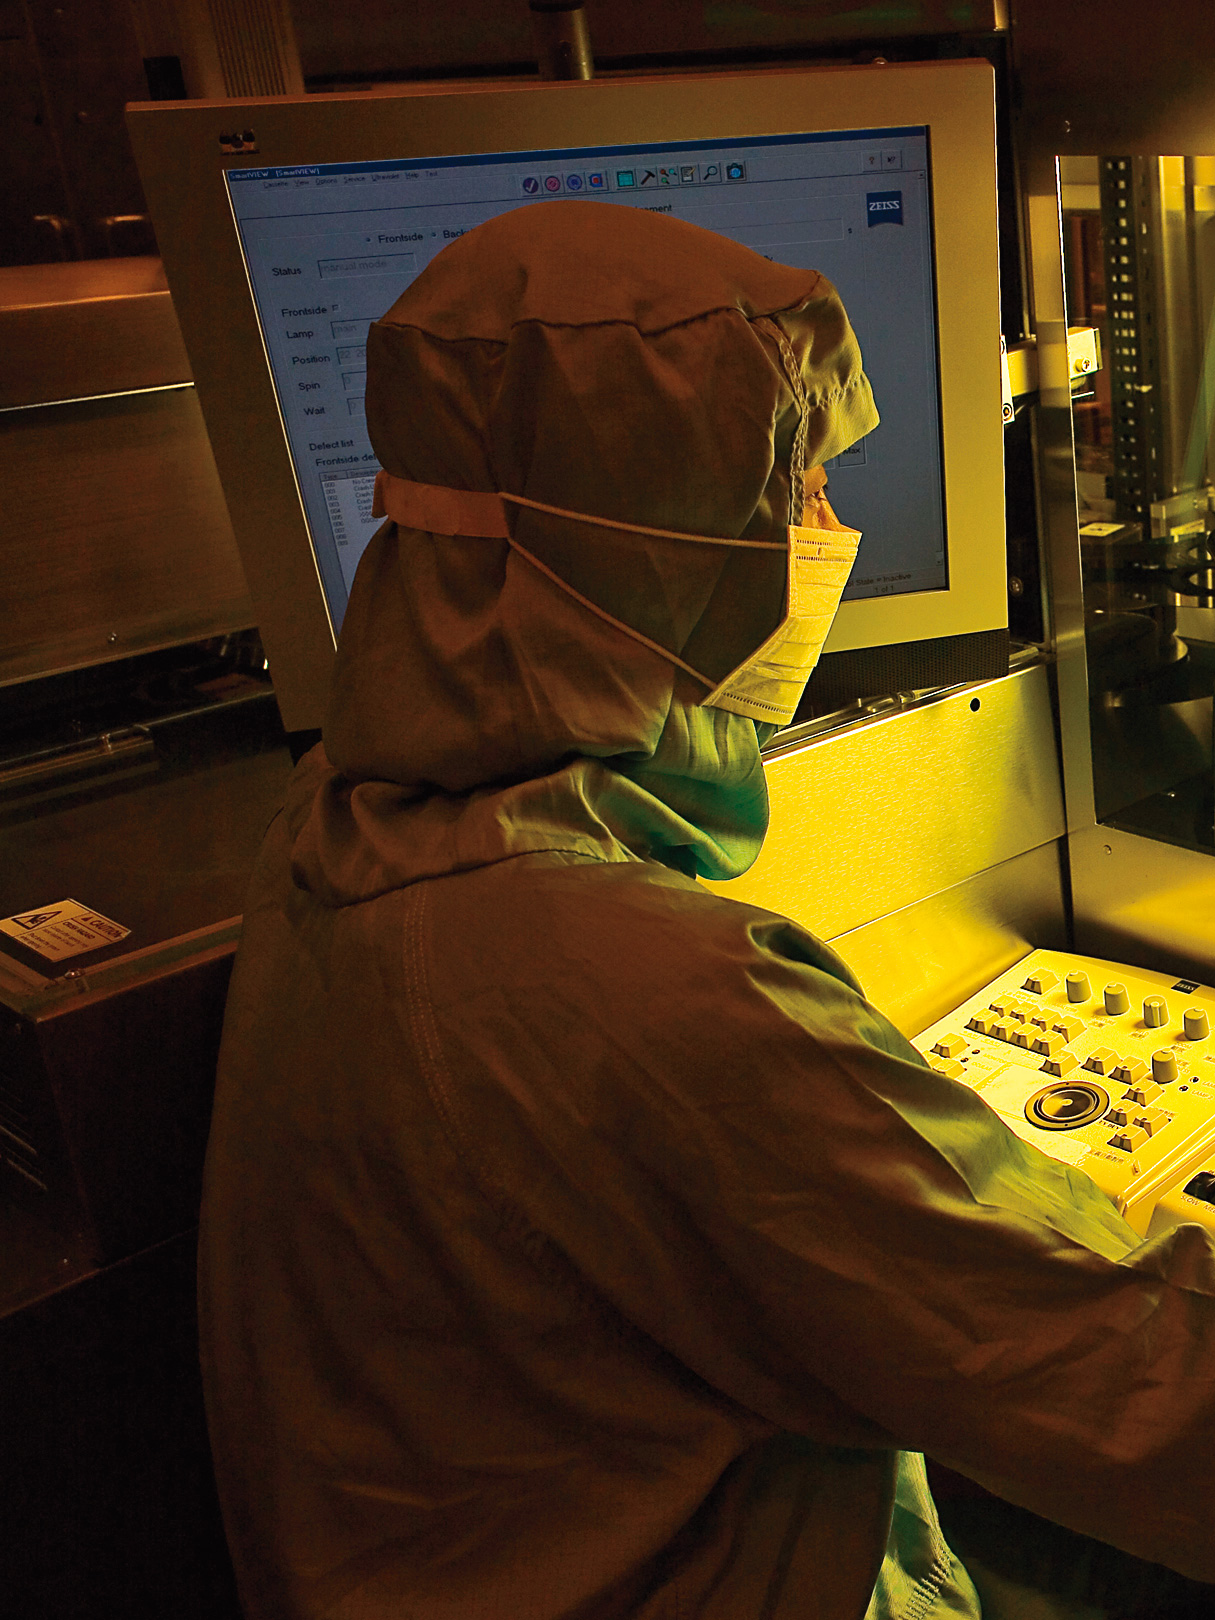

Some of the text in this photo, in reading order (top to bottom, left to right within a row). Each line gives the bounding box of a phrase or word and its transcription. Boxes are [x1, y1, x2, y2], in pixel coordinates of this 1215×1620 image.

[869, 200, 900, 211] ZEISS
[378, 233, 423, 243] Frontside
[272, 266, 302, 277] Status
[281, 306, 327, 317] Frontside
[286, 331, 313, 339] Lamp
[292, 355, 330, 364] Position
[298, 382, 320, 392] Spin
[304, 407, 325, 415] Wait
[309, 441, 339, 450] Defect
[316, 455, 359, 466] Frontside
[884, 574, 911, 582] Inactive
[1191, 1090, 1209, 1098] LAMP
[1180, 1195, 1200, 1205] SLOW
